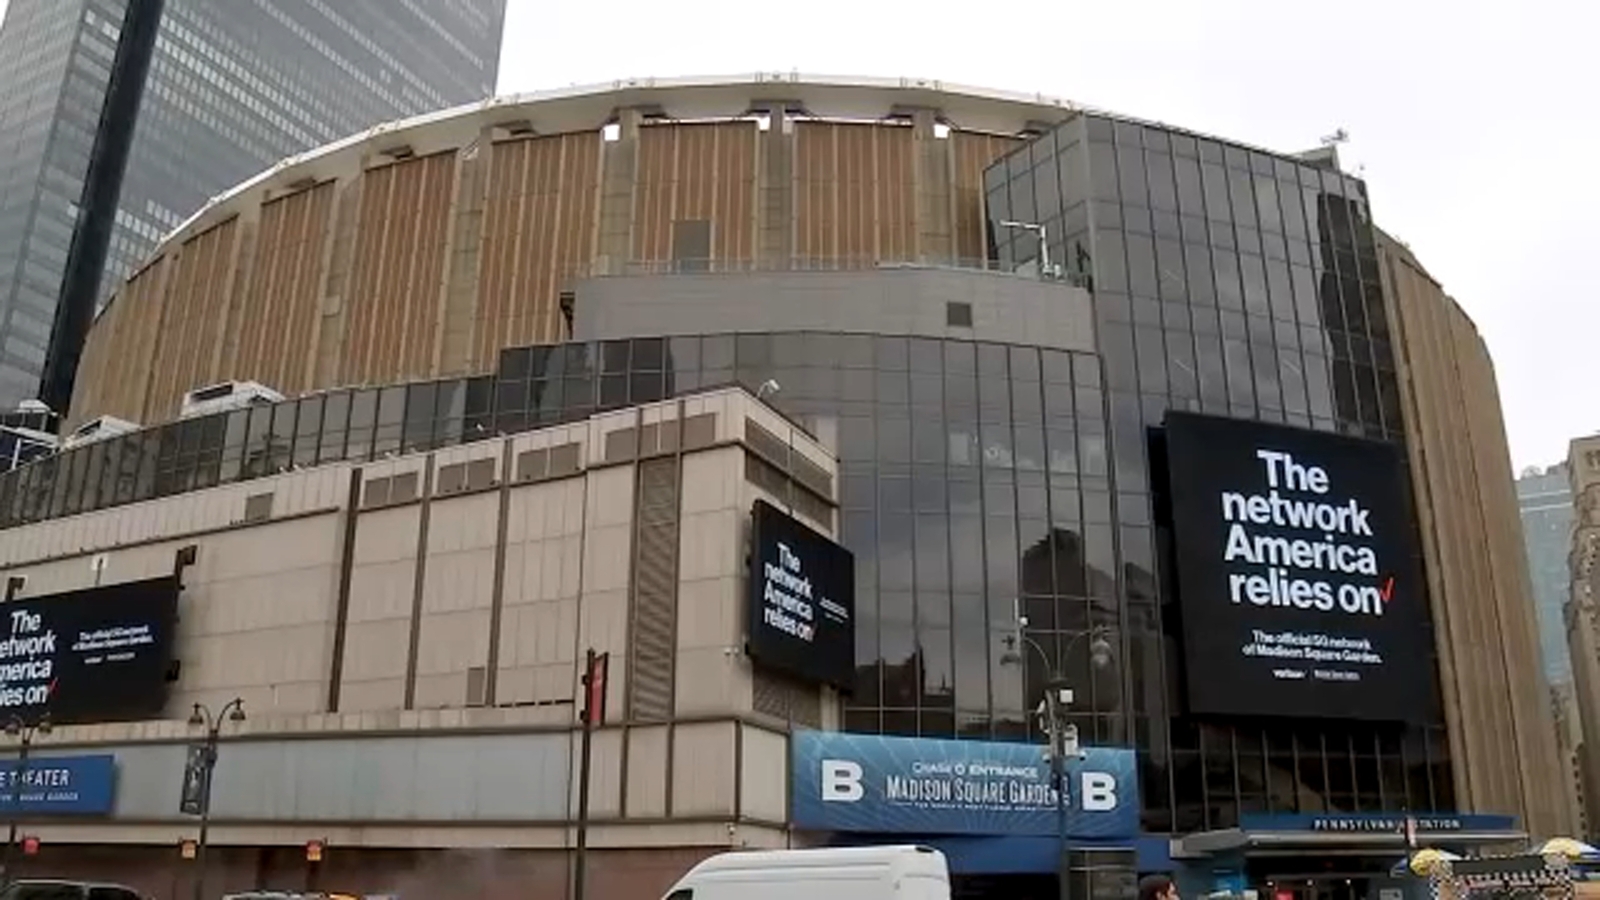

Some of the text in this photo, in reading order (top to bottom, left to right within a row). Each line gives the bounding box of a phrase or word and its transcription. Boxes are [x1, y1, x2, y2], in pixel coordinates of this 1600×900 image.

[1257, 450, 1329, 493] The
[1222, 490, 1373, 536] network
[777, 542, 801, 573] The
[1224, 523, 1377, 575] America
[764, 562, 813, 600] network
[1229, 568, 1383, 615] relies on
[764, 580, 813, 621] America
[11, 609, 41, 633] The
[0, 629, 57, 658] etwork
[0, 656, 51, 681] merica
[25, 685, 48, 705] on
[821, 759, 864, 801] B
[969, 763, 1038, 778] ENTRANCE
[886, 775, 951, 801] MADISON
[954, 777, 1006, 803] SQUARE
[1081, 771, 1118, 811] B
[1314, 819, 1404, 831] PENNSYLVANA
